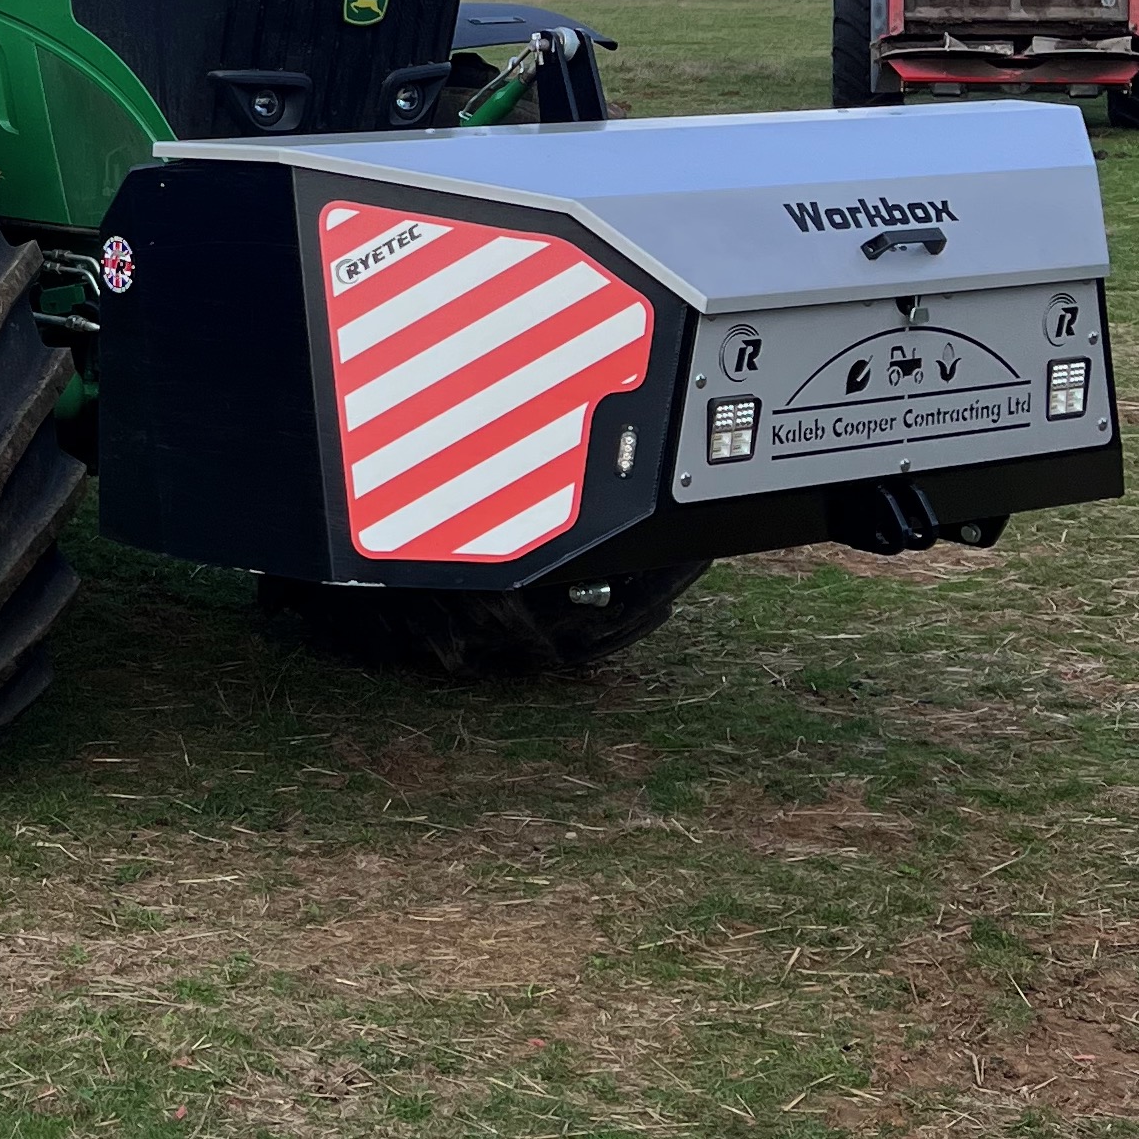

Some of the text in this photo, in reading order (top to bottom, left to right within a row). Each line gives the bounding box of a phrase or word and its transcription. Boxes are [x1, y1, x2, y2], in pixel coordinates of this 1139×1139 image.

[783, 196, 959, 233] Workbox
[345, 223, 422, 281] RYETEC
[772, 392, 1031, 446] Kaleb Cooper Contracting Ltd
